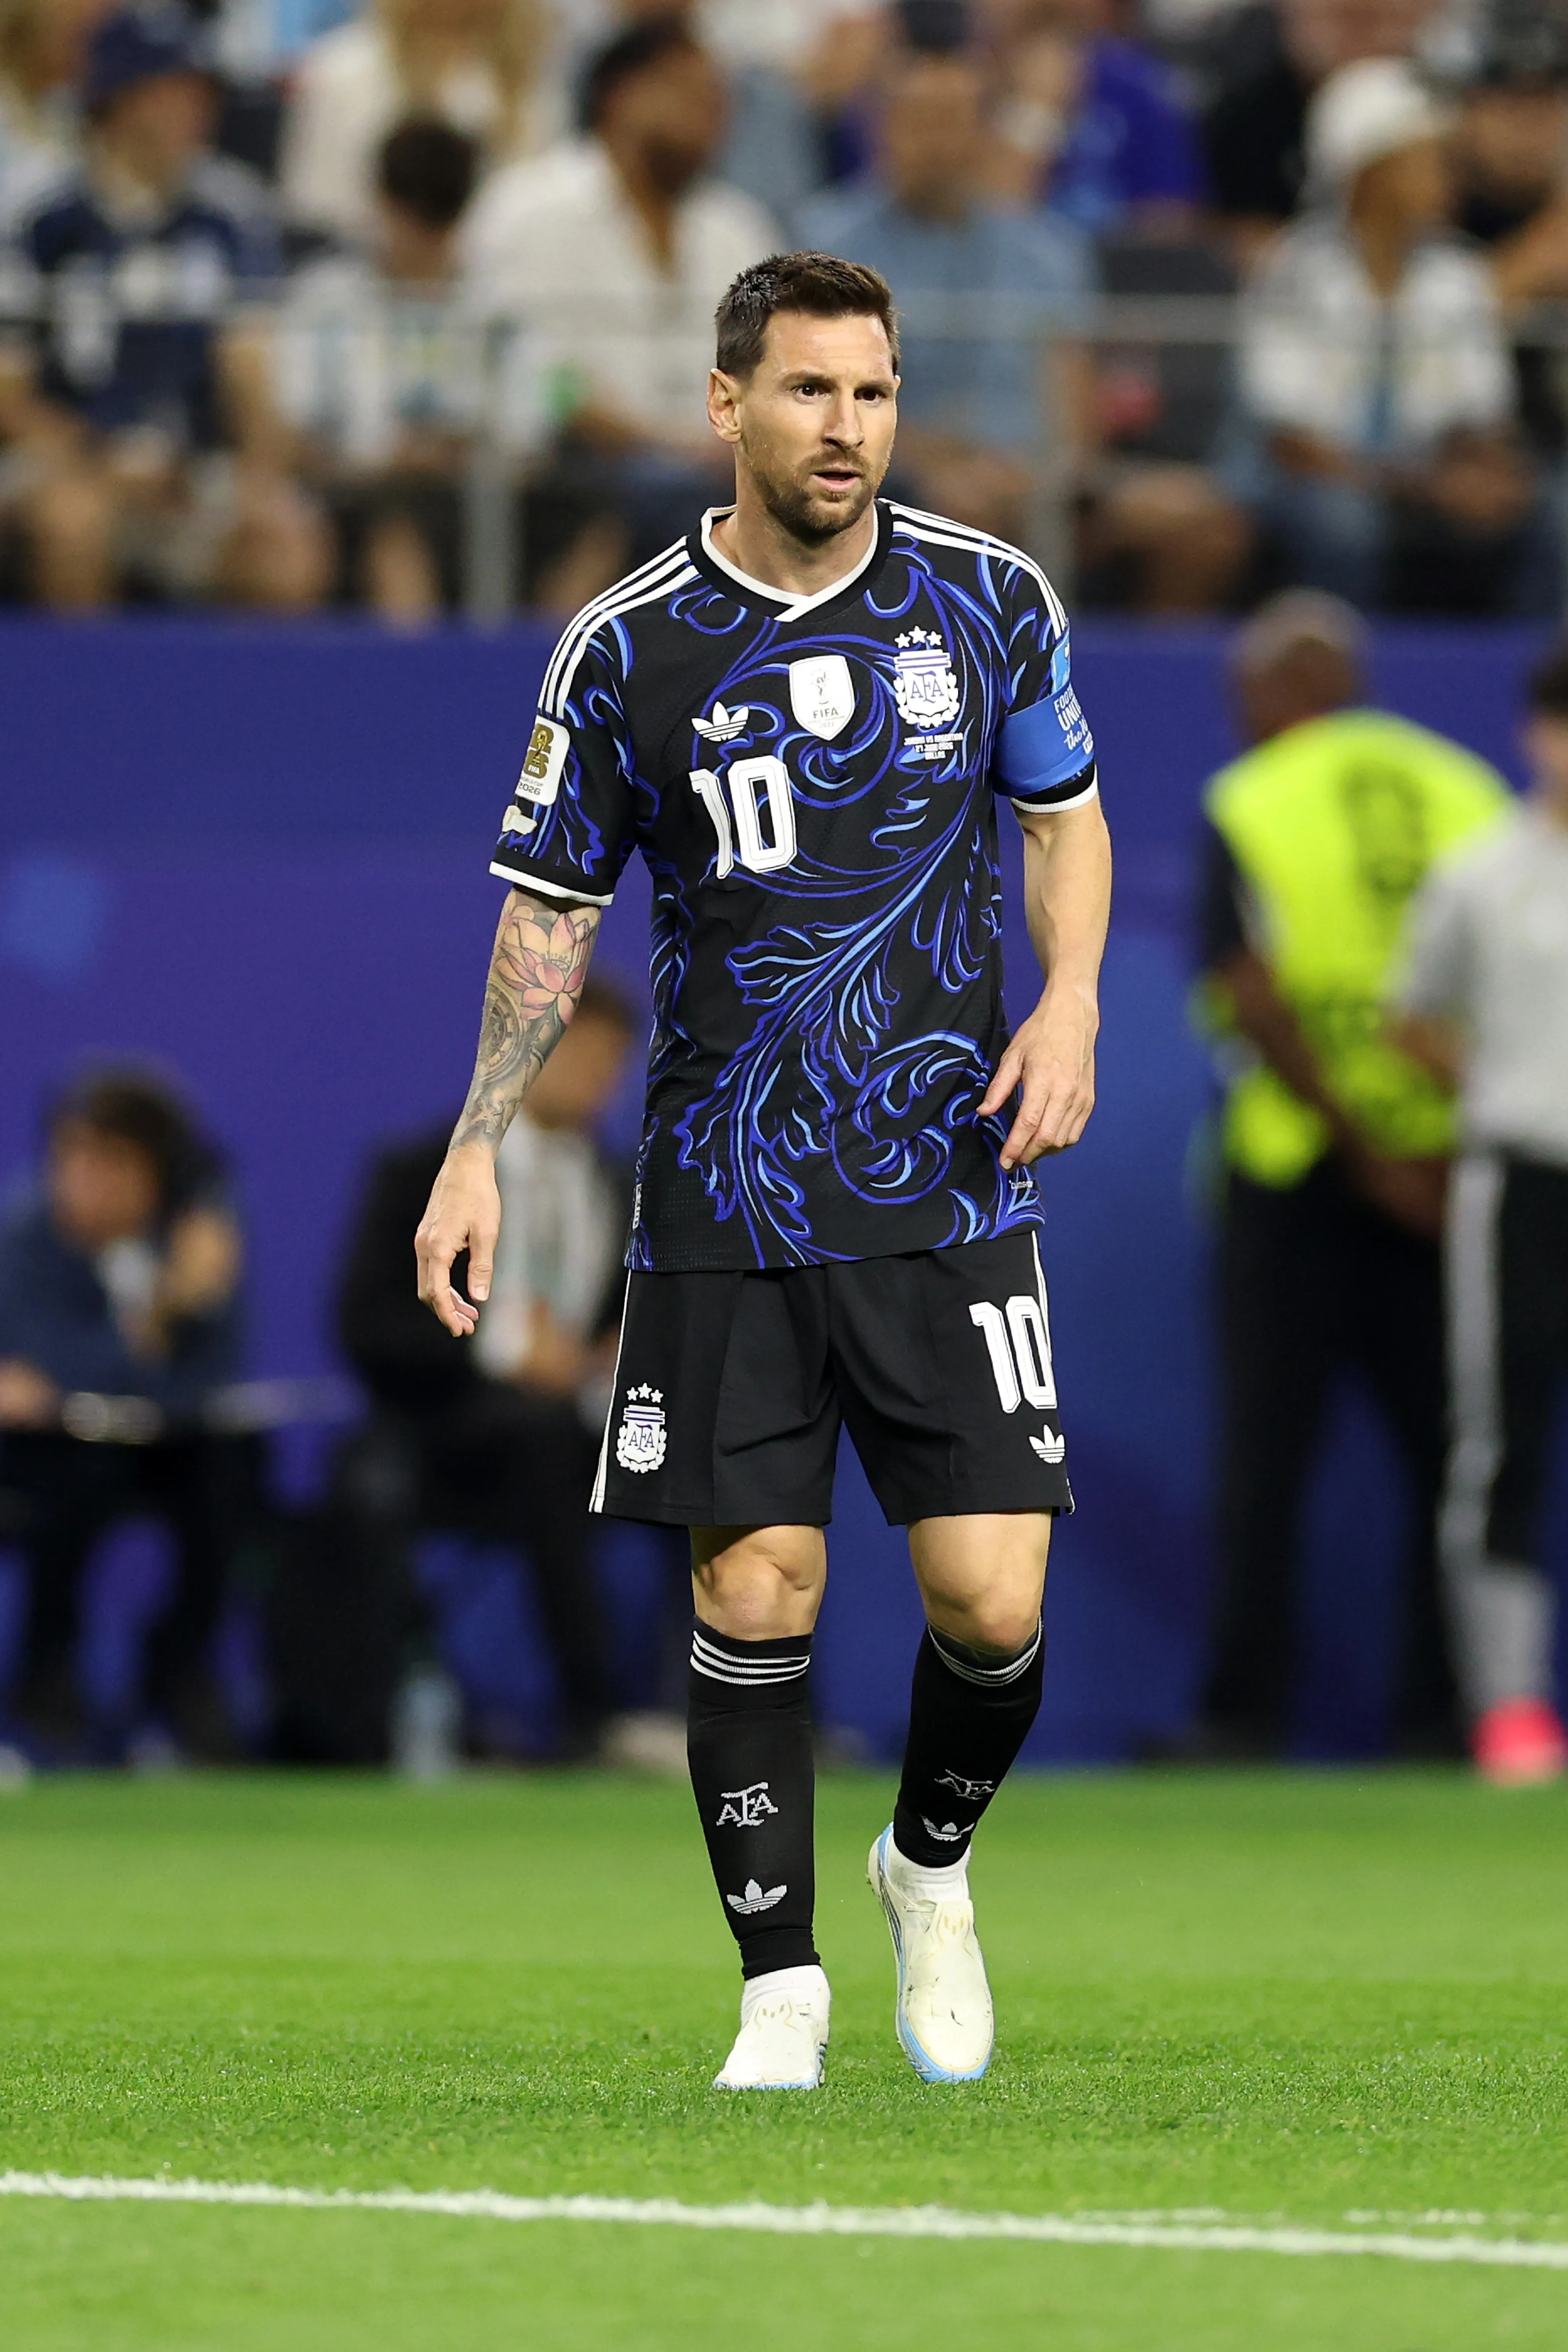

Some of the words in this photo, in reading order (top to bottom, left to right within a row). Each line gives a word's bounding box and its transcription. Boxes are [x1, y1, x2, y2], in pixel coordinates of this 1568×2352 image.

[910, 670, 944, 703] AFA
[813, 707, 838, 719] FIFA
[1063, 730, 1082, 750] the
[689, 755, 797, 879] 10
[969, 1296, 1057, 1414] 10
[628, 1423, 655, 1452] AFA
[934, 1769, 995, 1800] AFA
[716, 1782, 779, 1828] AFA
